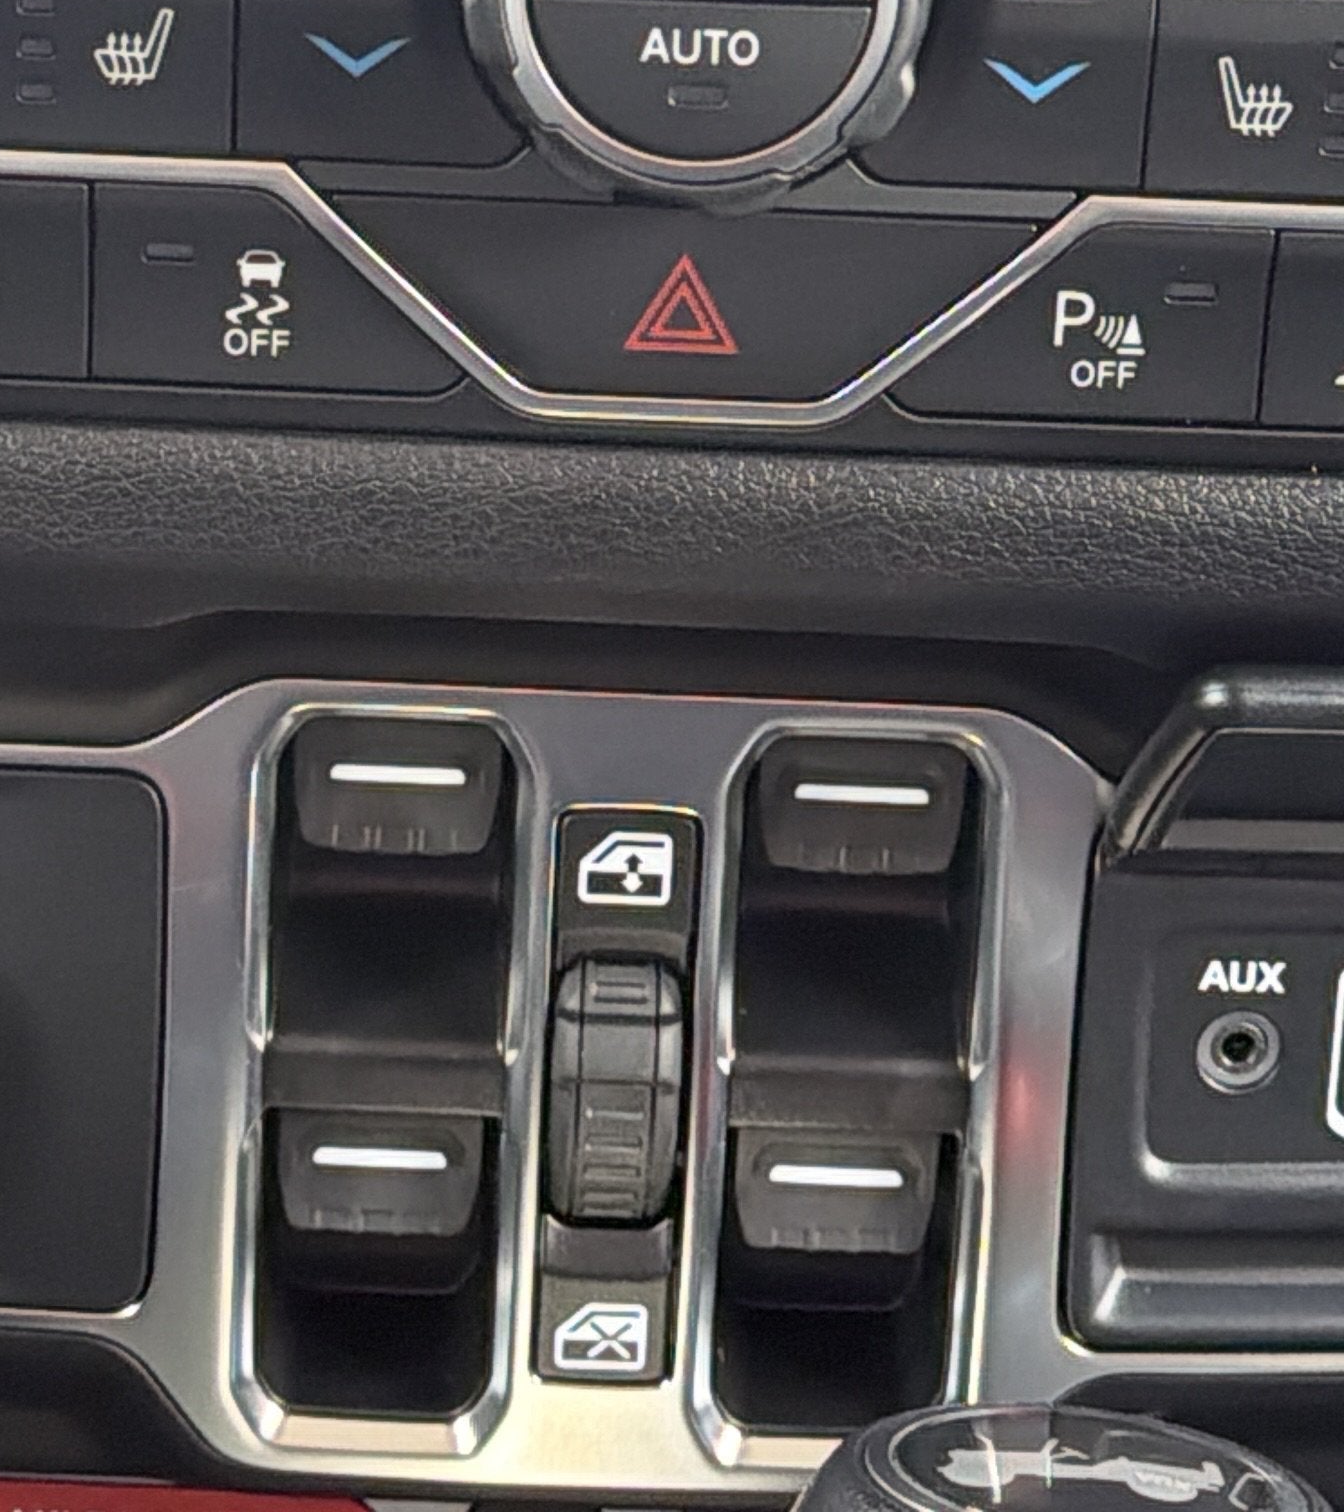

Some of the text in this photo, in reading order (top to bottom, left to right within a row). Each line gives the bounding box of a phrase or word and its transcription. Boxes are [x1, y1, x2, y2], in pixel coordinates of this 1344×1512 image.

[639, 27, 760, 66] AUTO
[1054, 290, 1096, 349] P
[222, 328, 291, 358] OFF
[1070, 360, 1138, 390] OFF
[1197, 960, 1287, 994] AUX
